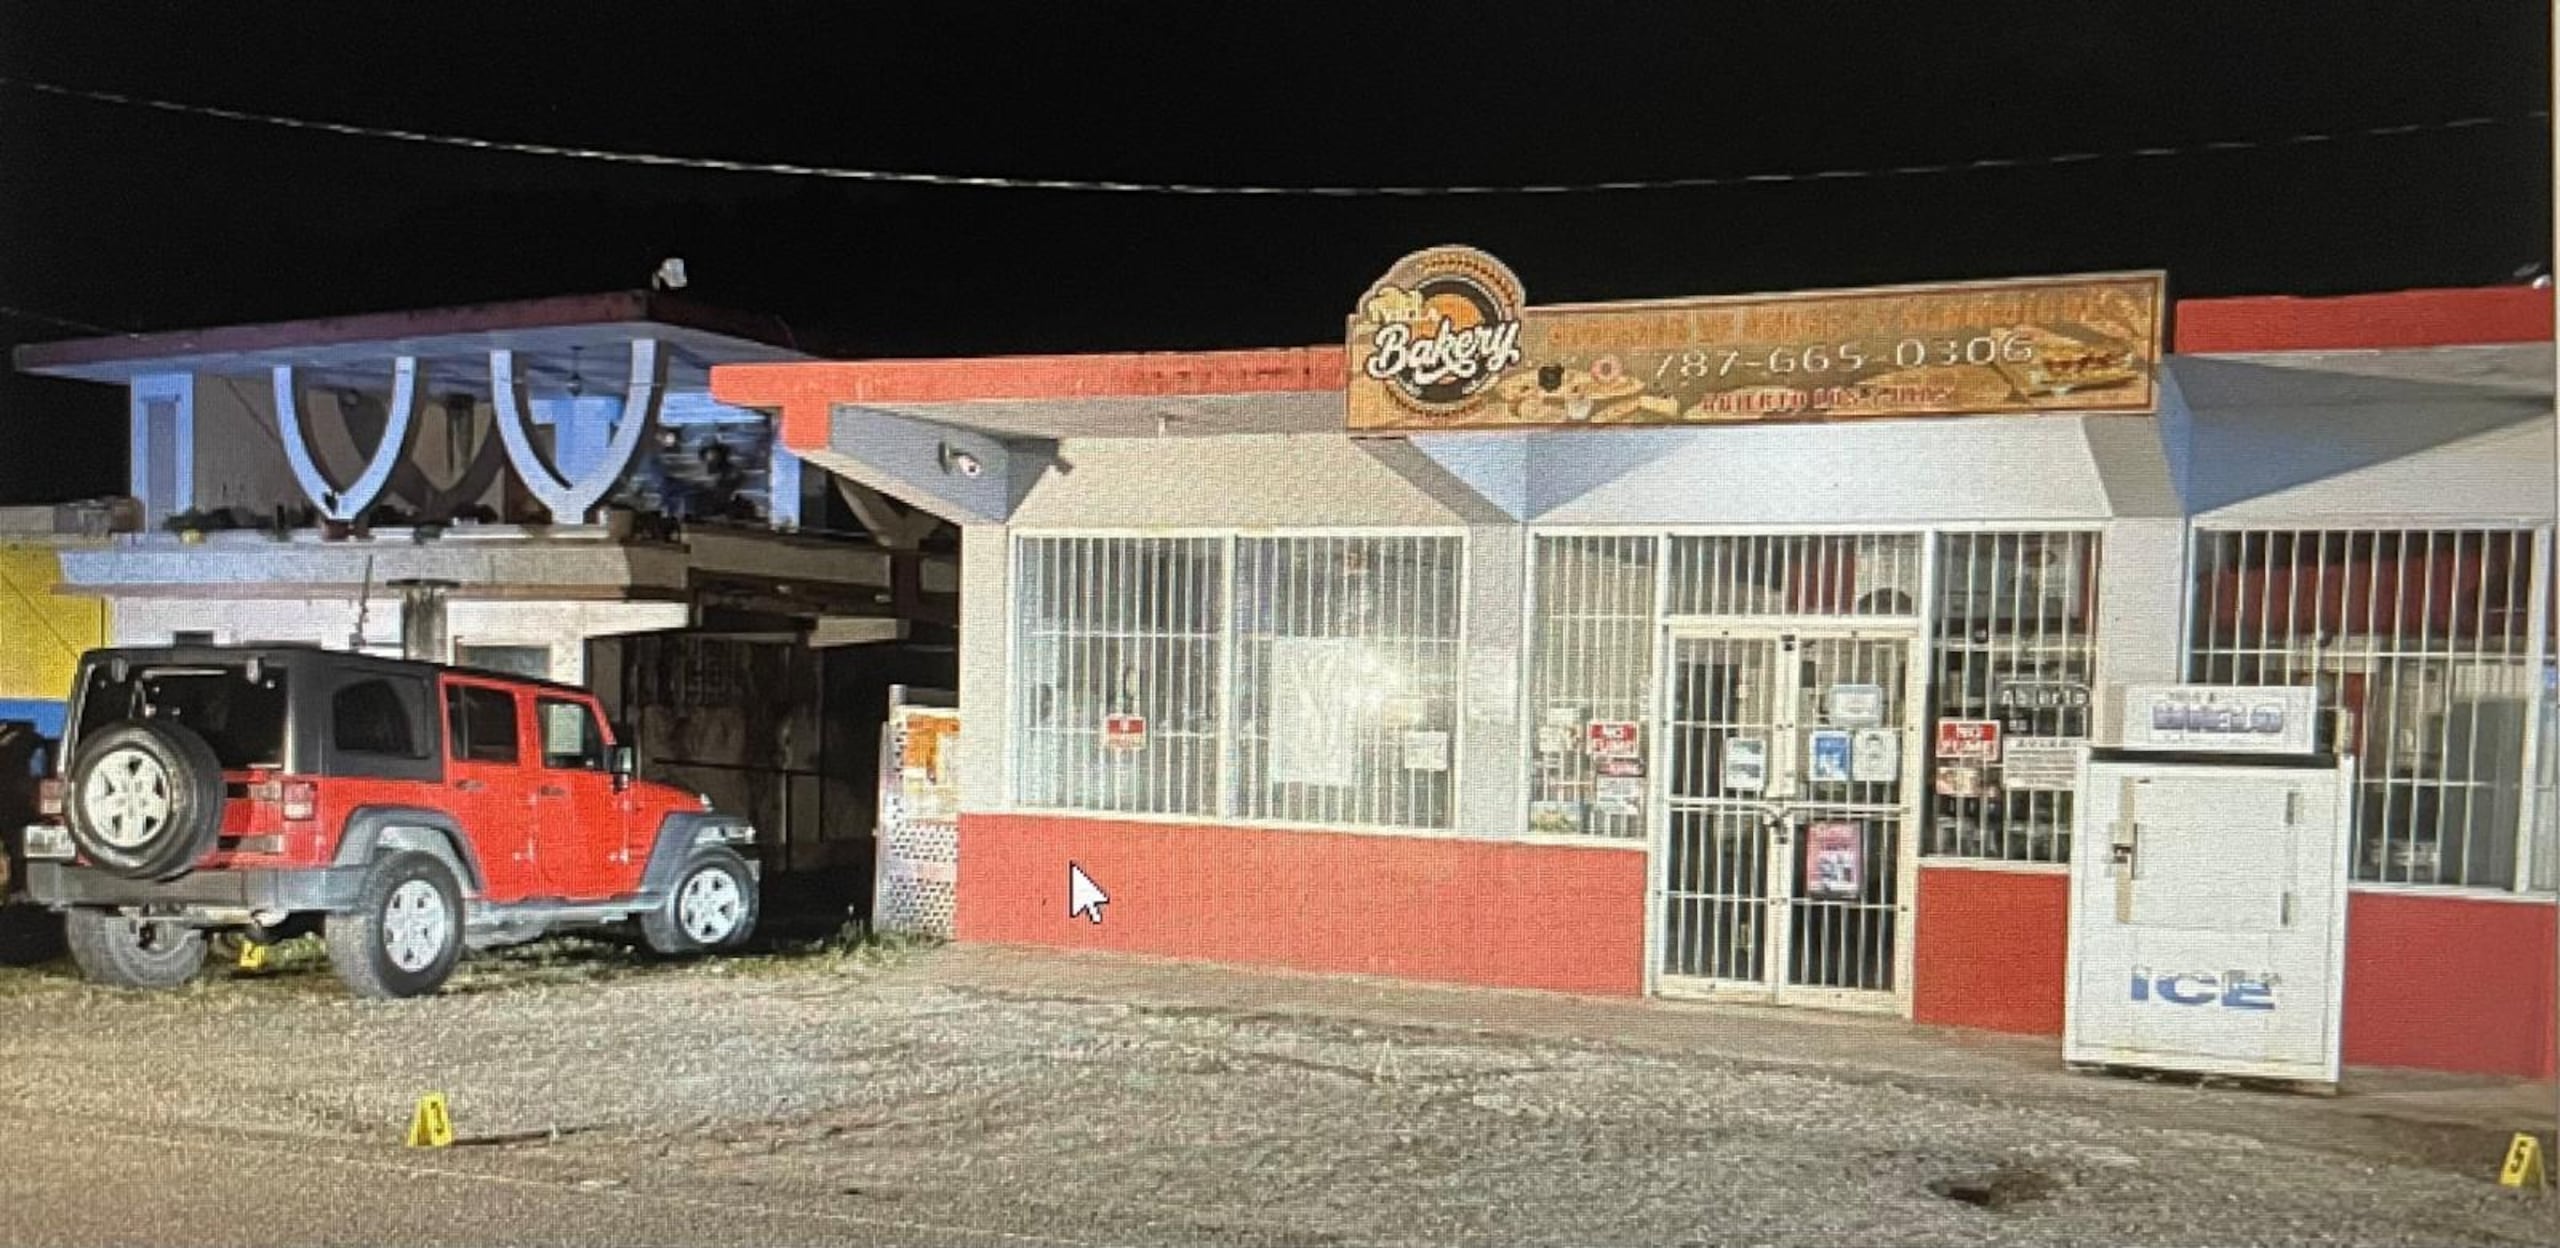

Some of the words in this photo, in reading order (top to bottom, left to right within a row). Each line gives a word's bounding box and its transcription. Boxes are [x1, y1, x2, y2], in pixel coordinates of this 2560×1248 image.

[1367, 318, 1521, 386] Bakery
[1654, 333, 2033, 378] 787-665-0306
[2130, 966, 2278, 1010] ICE
[2510, 1140, 2528, 1174] 5
